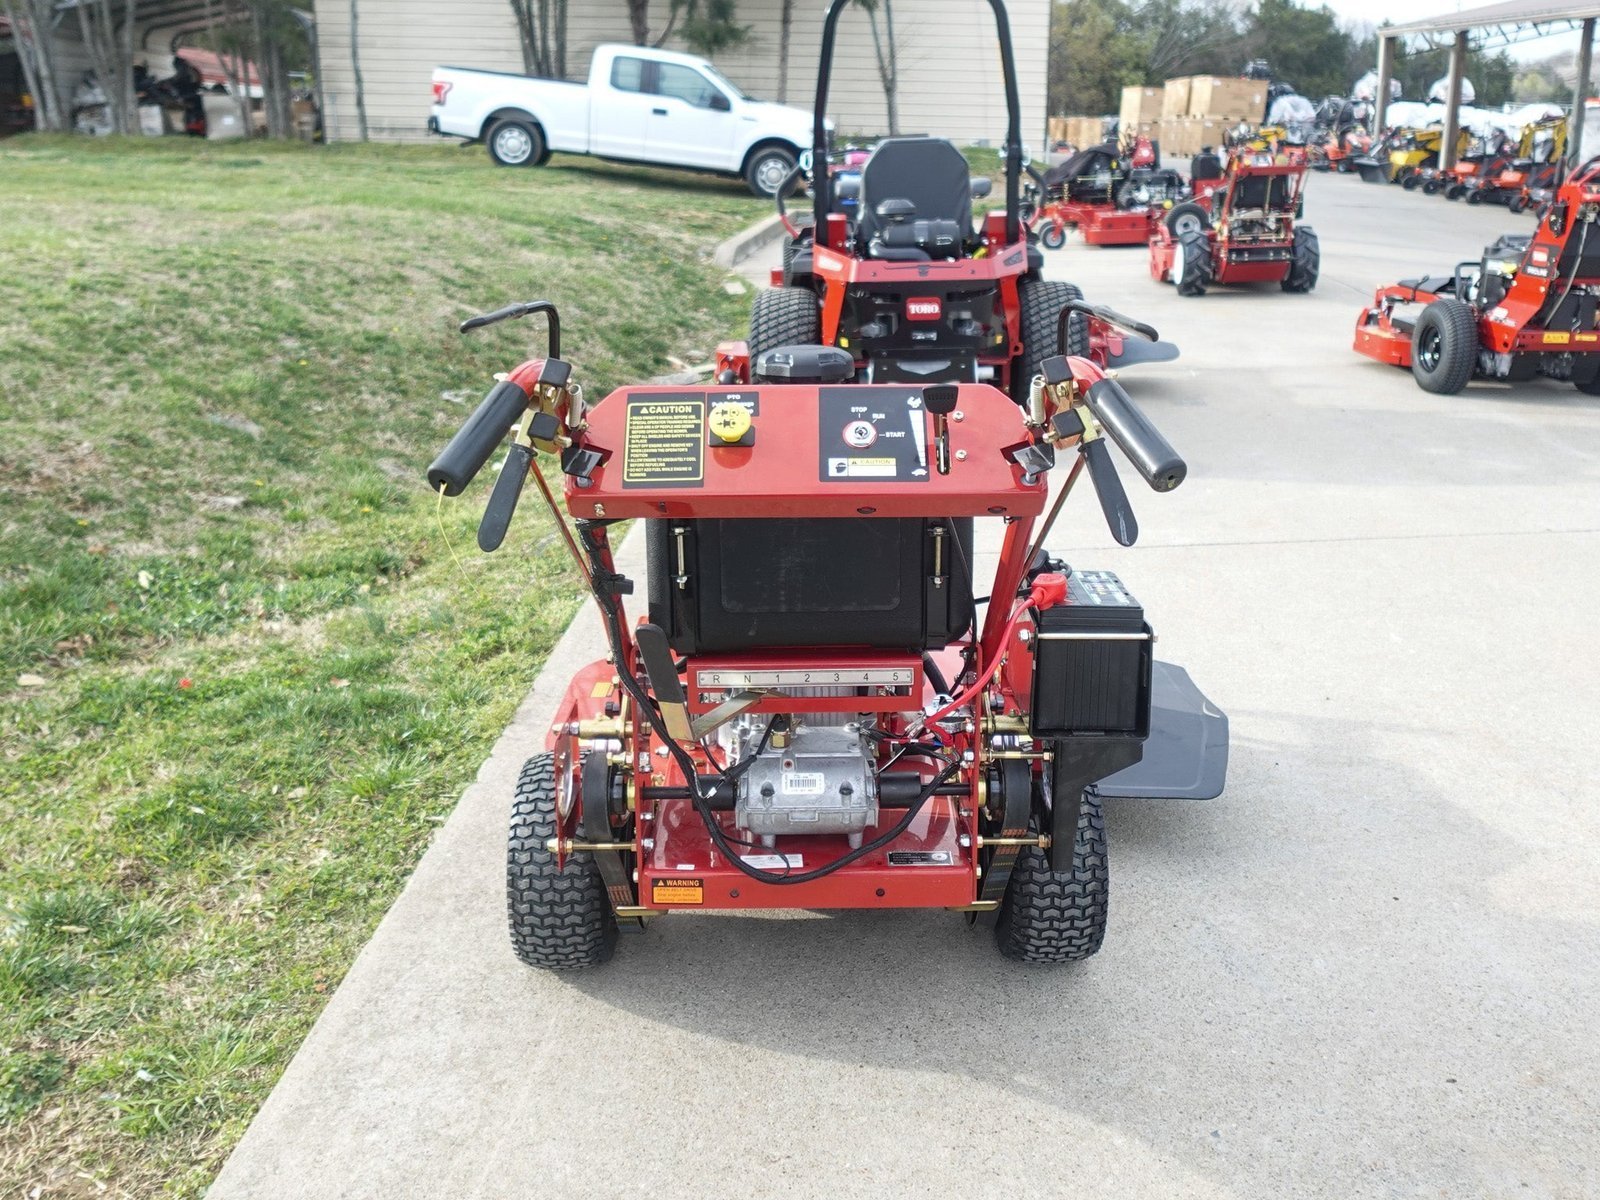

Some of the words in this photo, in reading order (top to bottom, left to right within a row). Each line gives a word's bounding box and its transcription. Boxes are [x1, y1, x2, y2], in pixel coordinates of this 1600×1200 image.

[909, 304, 939, 314] TORO
[713, 674, 720, 683] R
[744, 675, 751, 683] N
